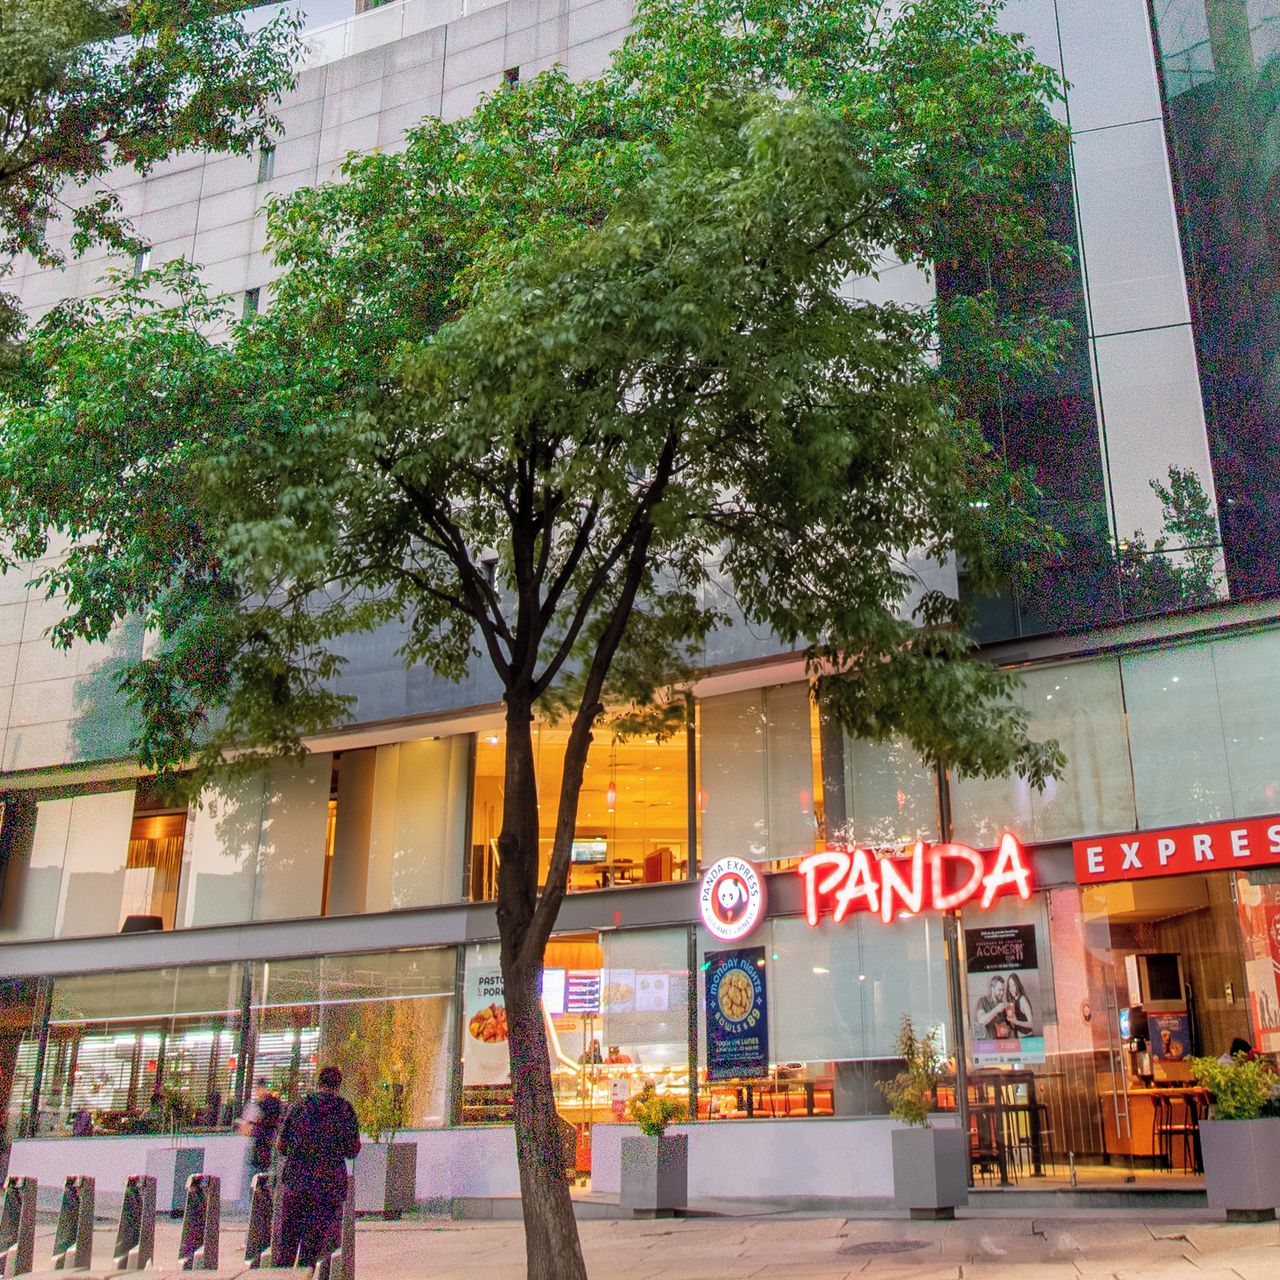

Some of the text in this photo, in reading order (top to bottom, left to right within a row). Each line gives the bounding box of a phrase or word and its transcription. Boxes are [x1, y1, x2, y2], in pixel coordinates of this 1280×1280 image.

[702, 860, 758, 901] PANDA EXPRESS
[797, 832, 1031, 927] PANDA
[479, 976, 505, 986] PASTO
[710, 958, 762, 995] MONDAY NIGHTS
[715, 1011, 742, 1033] BOWLS
